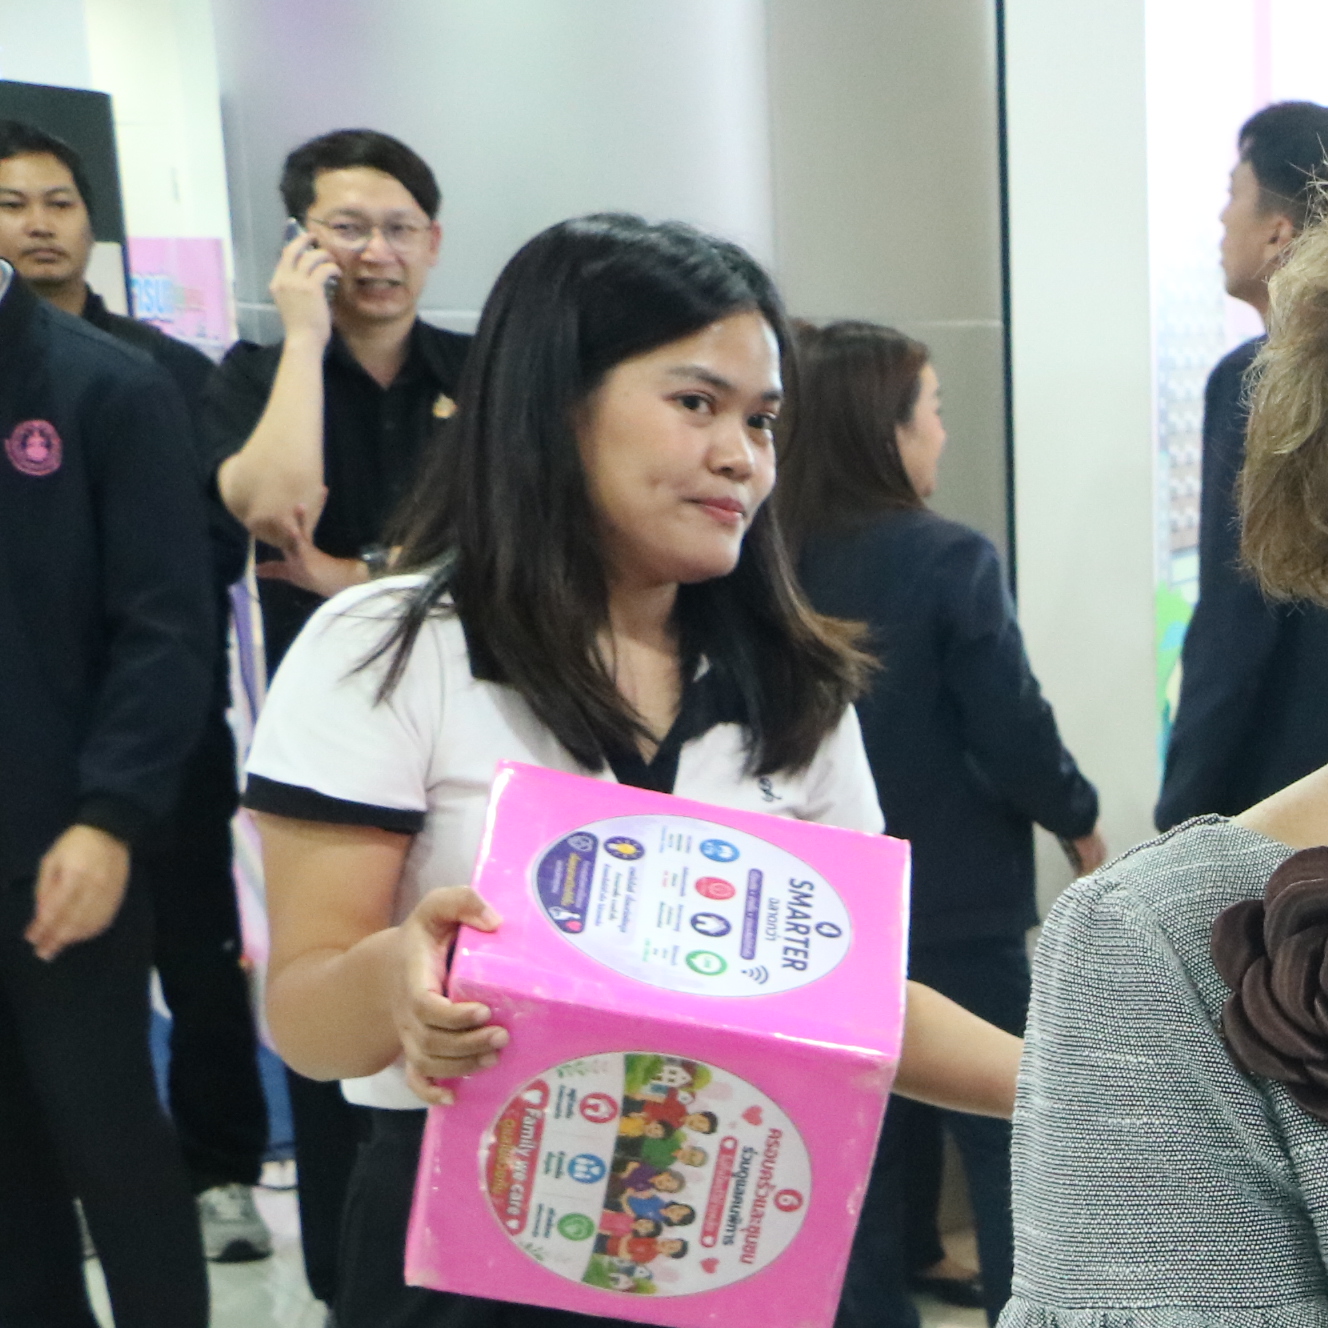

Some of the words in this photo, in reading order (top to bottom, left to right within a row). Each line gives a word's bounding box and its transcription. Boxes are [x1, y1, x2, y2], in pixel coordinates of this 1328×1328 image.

[781, 877, 815, 972] SMARTER
[511, 1107, 542, 1156] Family
[505, 1184, 524, 1216] care
[739, 1128, 783, 1264] ครอบครัวและชุมชน
